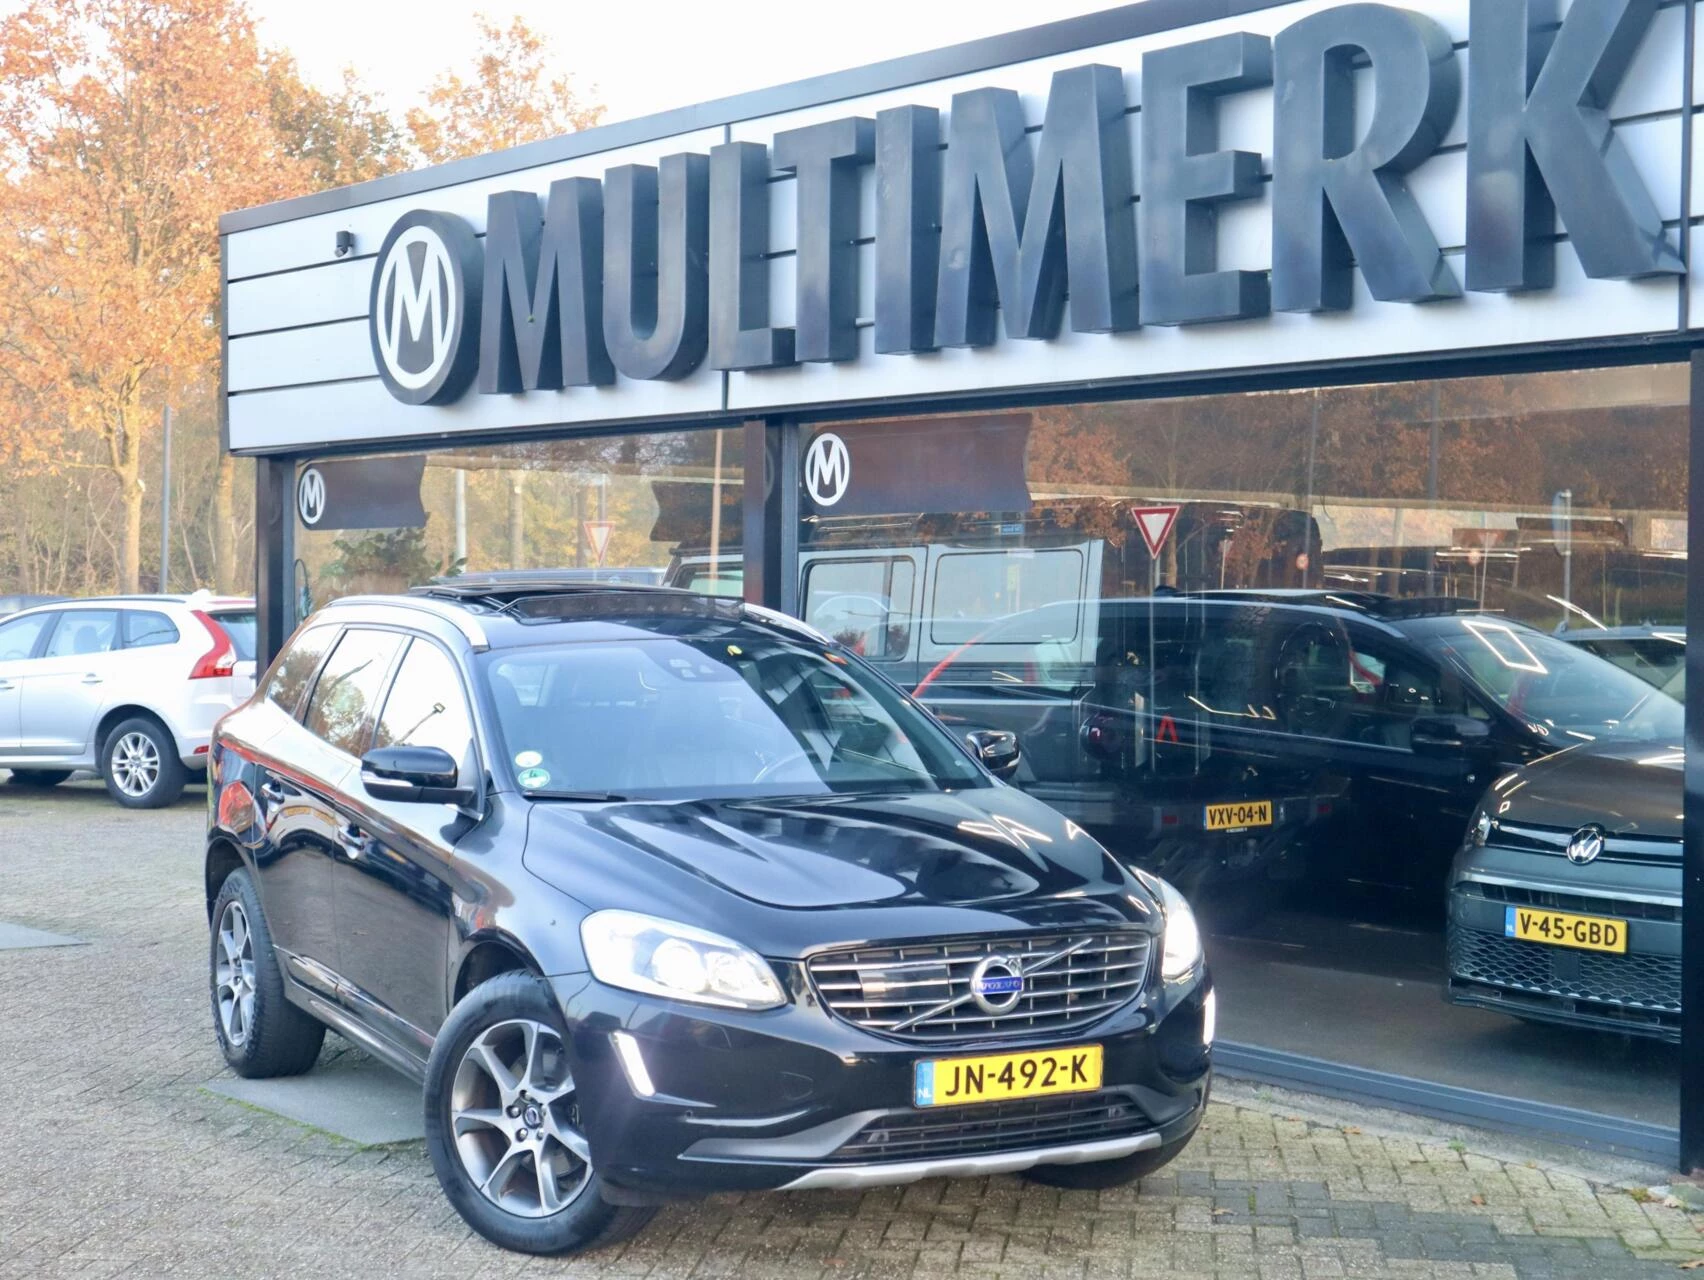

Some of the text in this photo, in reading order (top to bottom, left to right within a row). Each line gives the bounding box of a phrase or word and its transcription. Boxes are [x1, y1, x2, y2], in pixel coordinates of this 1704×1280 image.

[479, 0, 1686, 394] MULTIMERK
[384, 234, 449, 375] M
[808, 434, 846, 502] M
[301, 470, 323, 522] M
[1209, 805, 1267, 826] VXV-04-N
[1520, 912, 1618, 947] V-45-GBD
[918, 1087, 932, 1099] NL
[945, 1054, 1088, 1097] JN-492-K
